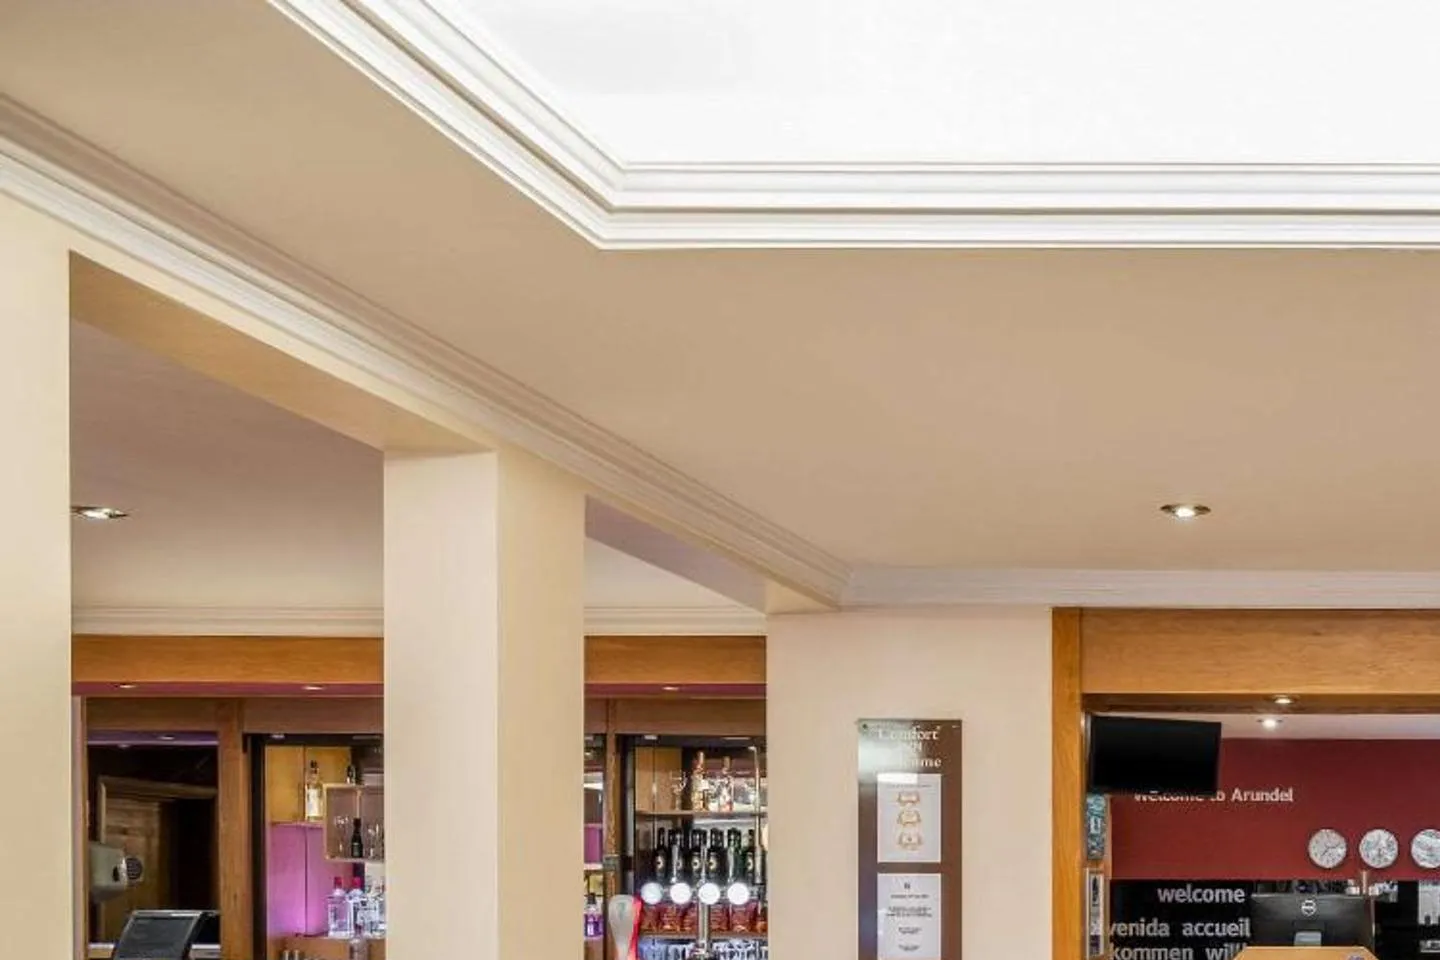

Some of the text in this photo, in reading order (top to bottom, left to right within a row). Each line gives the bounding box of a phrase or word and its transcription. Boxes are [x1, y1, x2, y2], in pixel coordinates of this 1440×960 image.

[1231, 787, 1294, 802] Arundel
[1157, 883, 1246, 903] welcome
[1182, 917, 1251, 937] accueil
[1109, 942, 1194, 960] kommen
